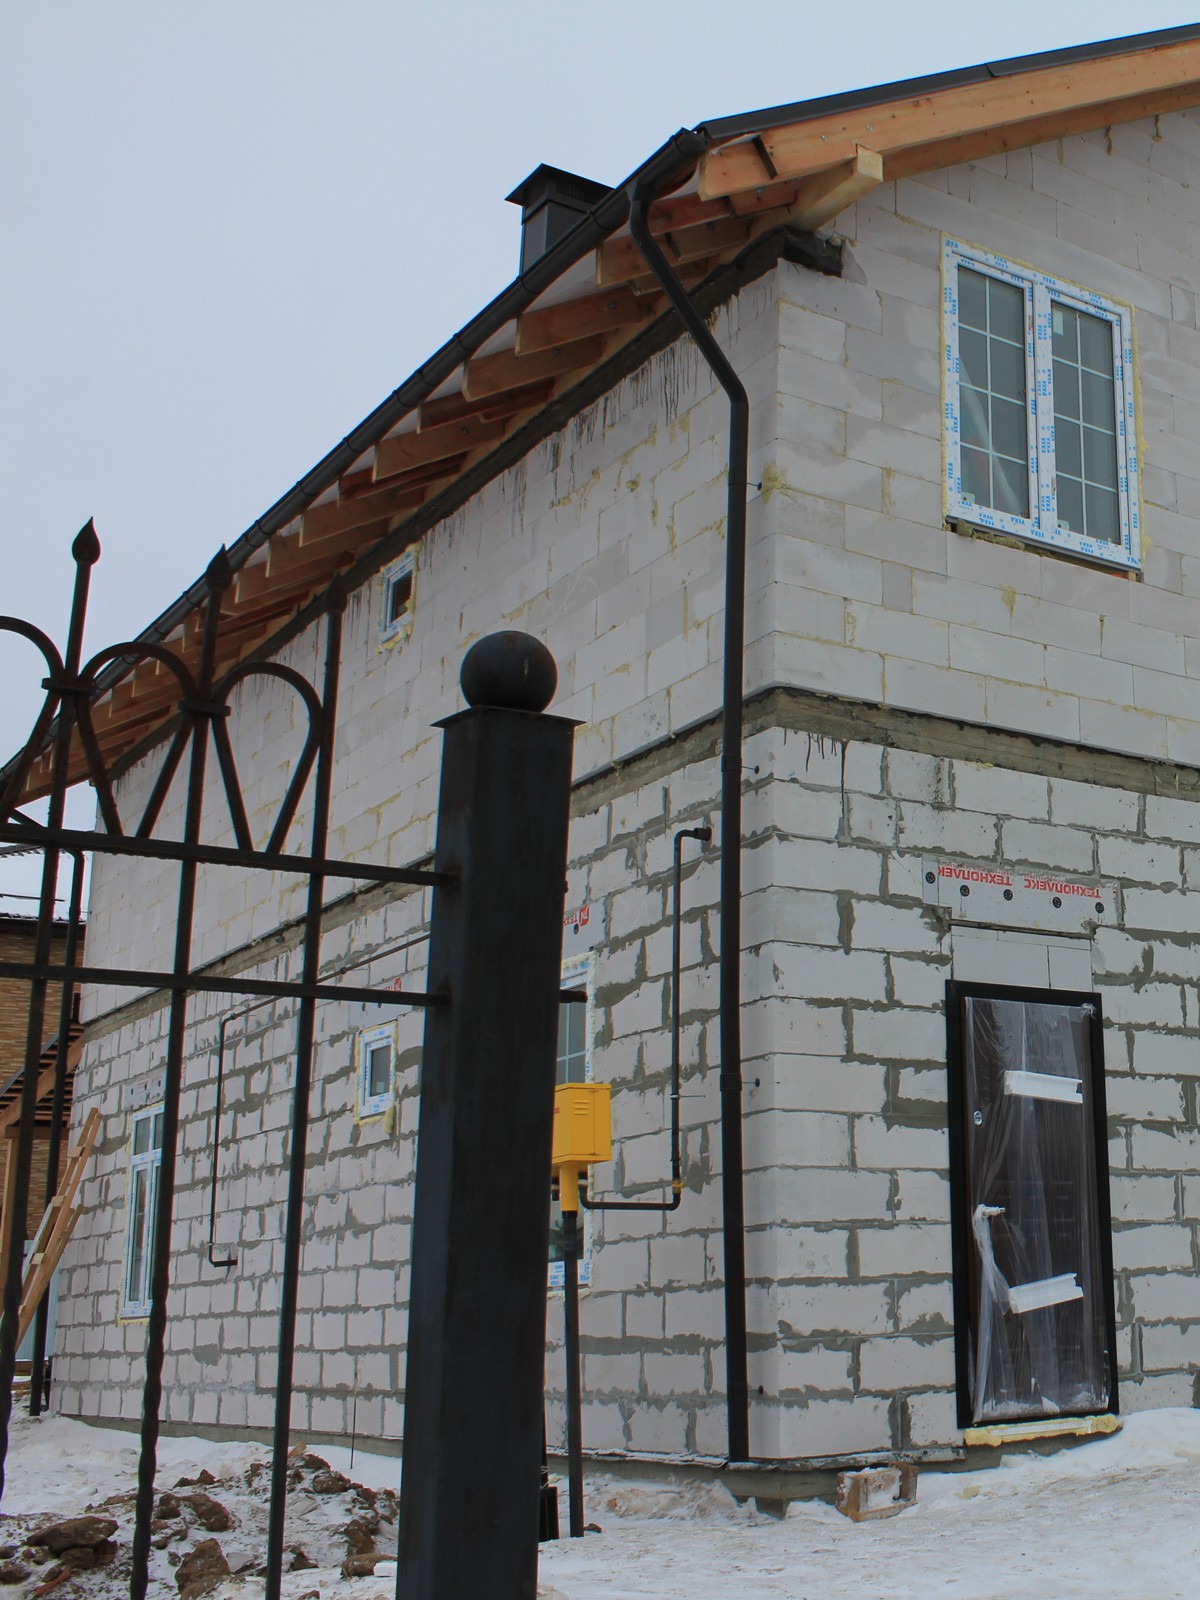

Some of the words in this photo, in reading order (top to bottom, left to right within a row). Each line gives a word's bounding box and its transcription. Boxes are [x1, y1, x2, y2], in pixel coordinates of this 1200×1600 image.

[1010, 516, 1025, 525] VEKA
[1030, 529, 1045, 538] VEKA
[938, 866, 1013, 887] ТЕХНОПЛЕК
[1024, 879, 1102, 899] ТЕХНОПЛЕКС
